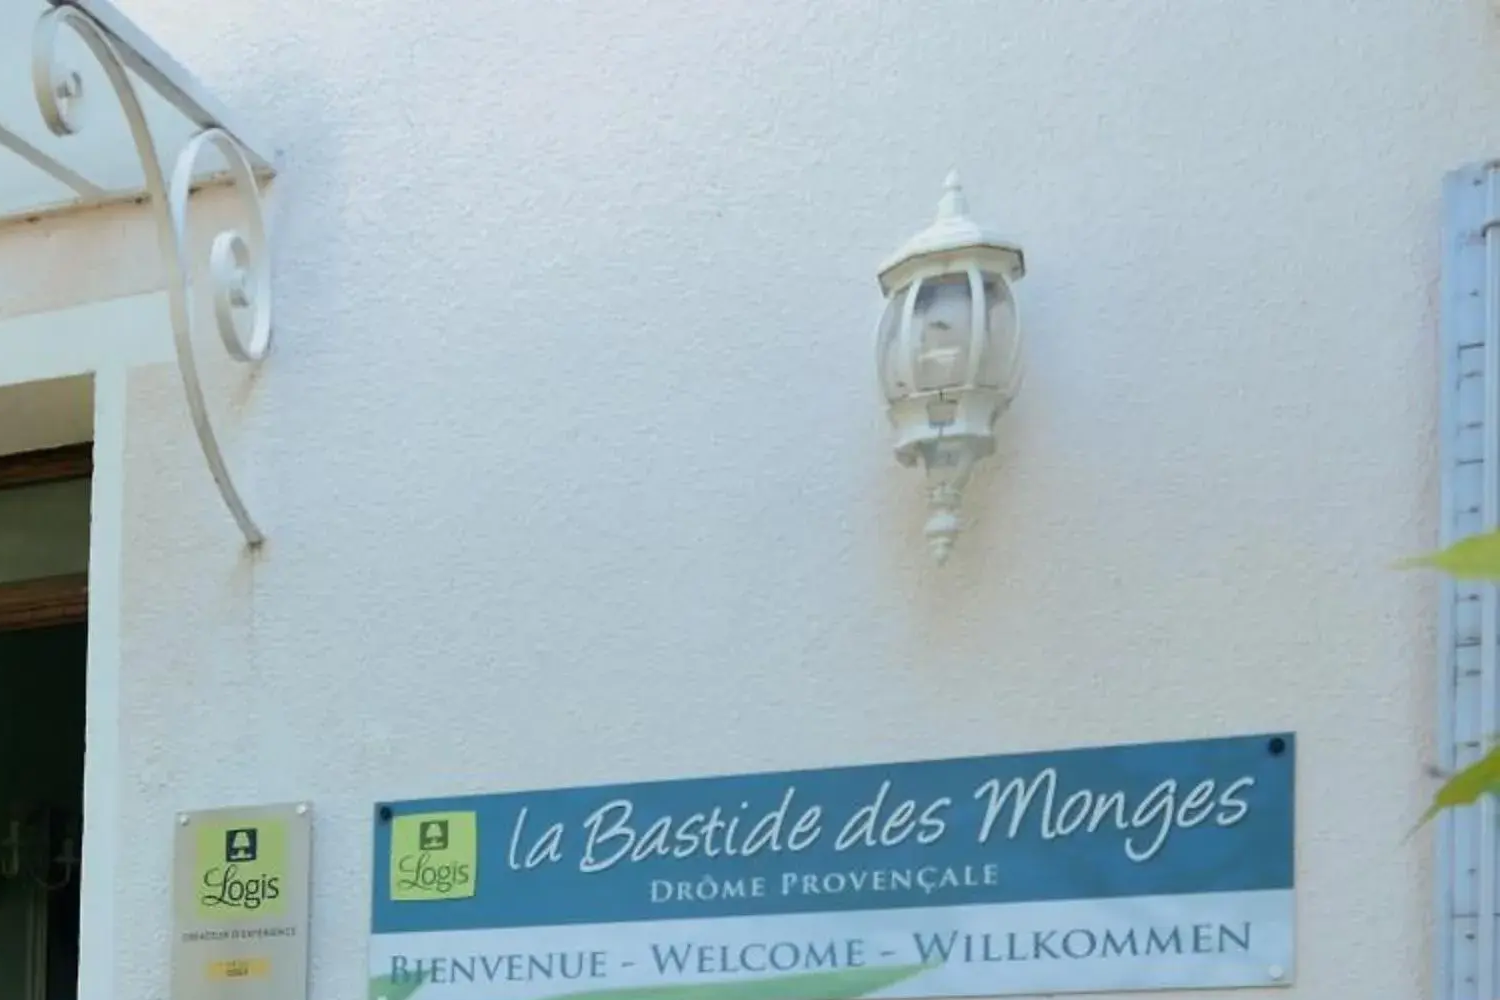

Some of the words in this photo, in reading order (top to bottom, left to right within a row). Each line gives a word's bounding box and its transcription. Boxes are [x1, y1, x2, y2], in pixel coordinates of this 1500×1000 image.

[507, 807, 565, 870] la
[579, 787, 823, 873] Bastide
[835, 780, 952, 852] des
[973, 768, 1255, 862] Monges
[201, 864, 280, 909] Logis
[397, 852, 470, 893] Logis
[650, 875, 765, 904] DRÔME
[780, 863, 999, 896] PROVENÇALE
[389, 949, 609, 985] BIENVENUE
[650, 938, 866, 976] WELCOME
[911, 921, 1252, 965] WILLKOMMEN
